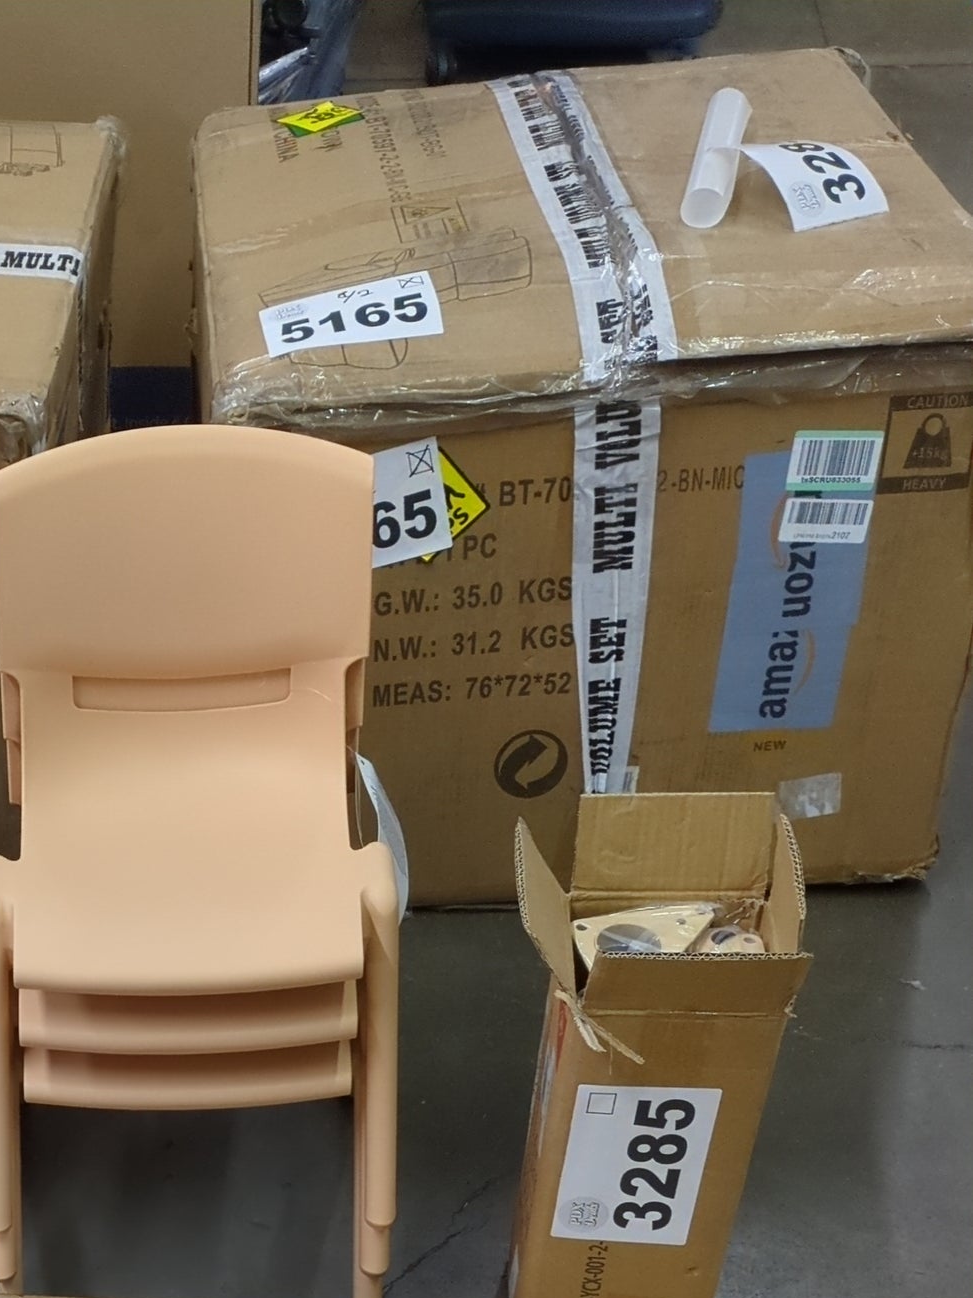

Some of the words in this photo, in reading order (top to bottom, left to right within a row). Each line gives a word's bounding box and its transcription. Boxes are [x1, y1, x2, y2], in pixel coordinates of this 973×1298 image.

[0, 251, 81, 277] MULTI
[281, 293, 428, 344] 5165
[907, 394, 970, 409] CAUTION
[903, 478, 946, 490] HEAVY
[373, 489, 437, 549] 65
[592, 482, 638, 574] MULTI
[463, 532, 498, 560] PC
[373, 588, 440, 616] G.W.:
[452, 581, 503, 610] 35.0
[518, 576, 573, 605] KGS
[373, 635, 437, 663] N.W.:
[451, 629, 501, 656] 31.2
[521, 622, 576, 650] KGS
[588, 616, 628, 665] SET
[372, 680, 452, 708] MEAS:
[753, 740, 787, 753] NEW
[612, 1098, 696, 1231] 3285
